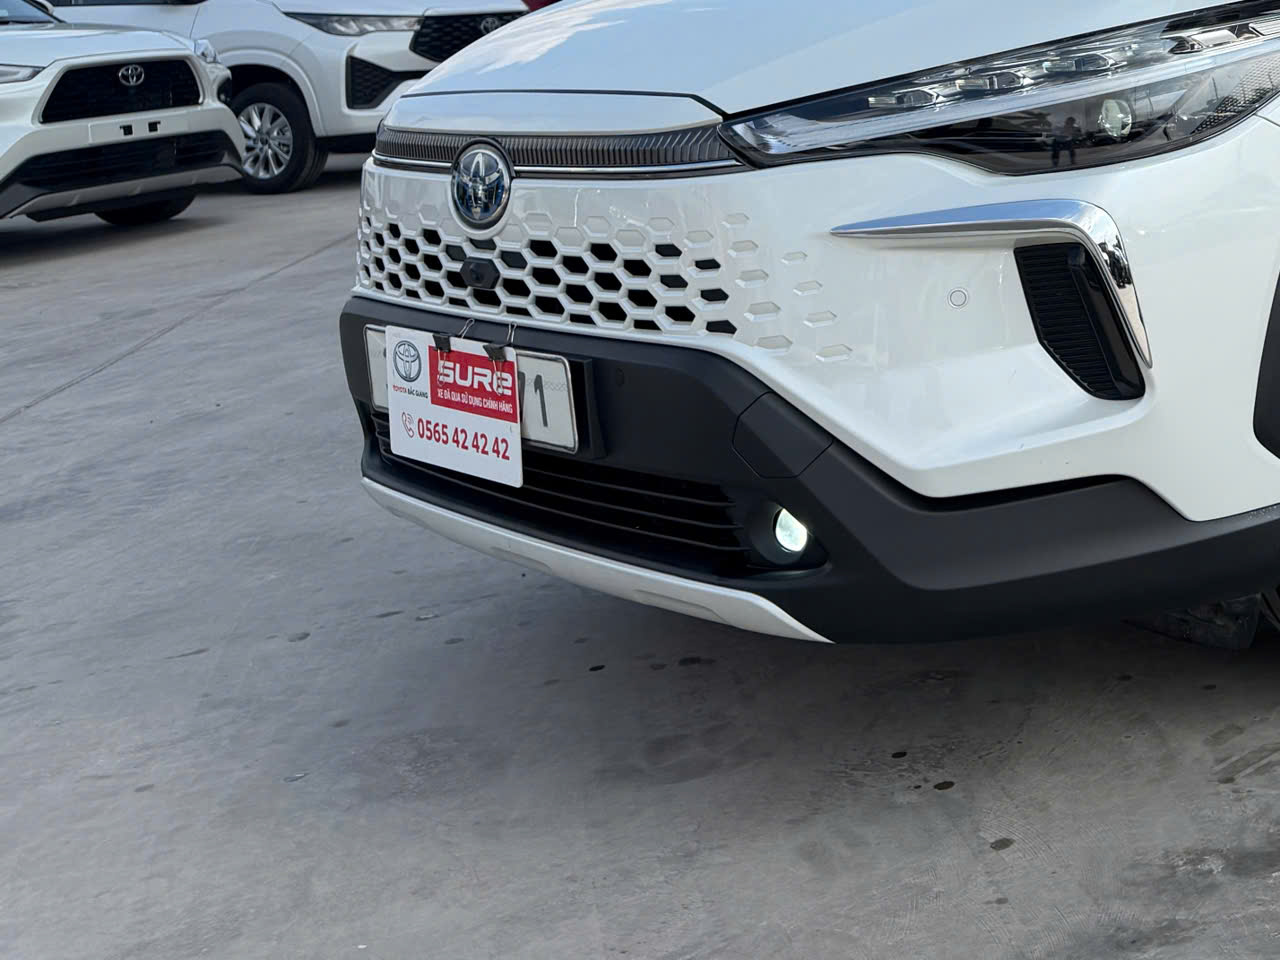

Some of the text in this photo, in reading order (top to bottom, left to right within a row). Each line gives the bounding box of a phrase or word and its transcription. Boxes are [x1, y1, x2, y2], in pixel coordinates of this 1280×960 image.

[417, 417, 510, 461] 0565 42 42 42
